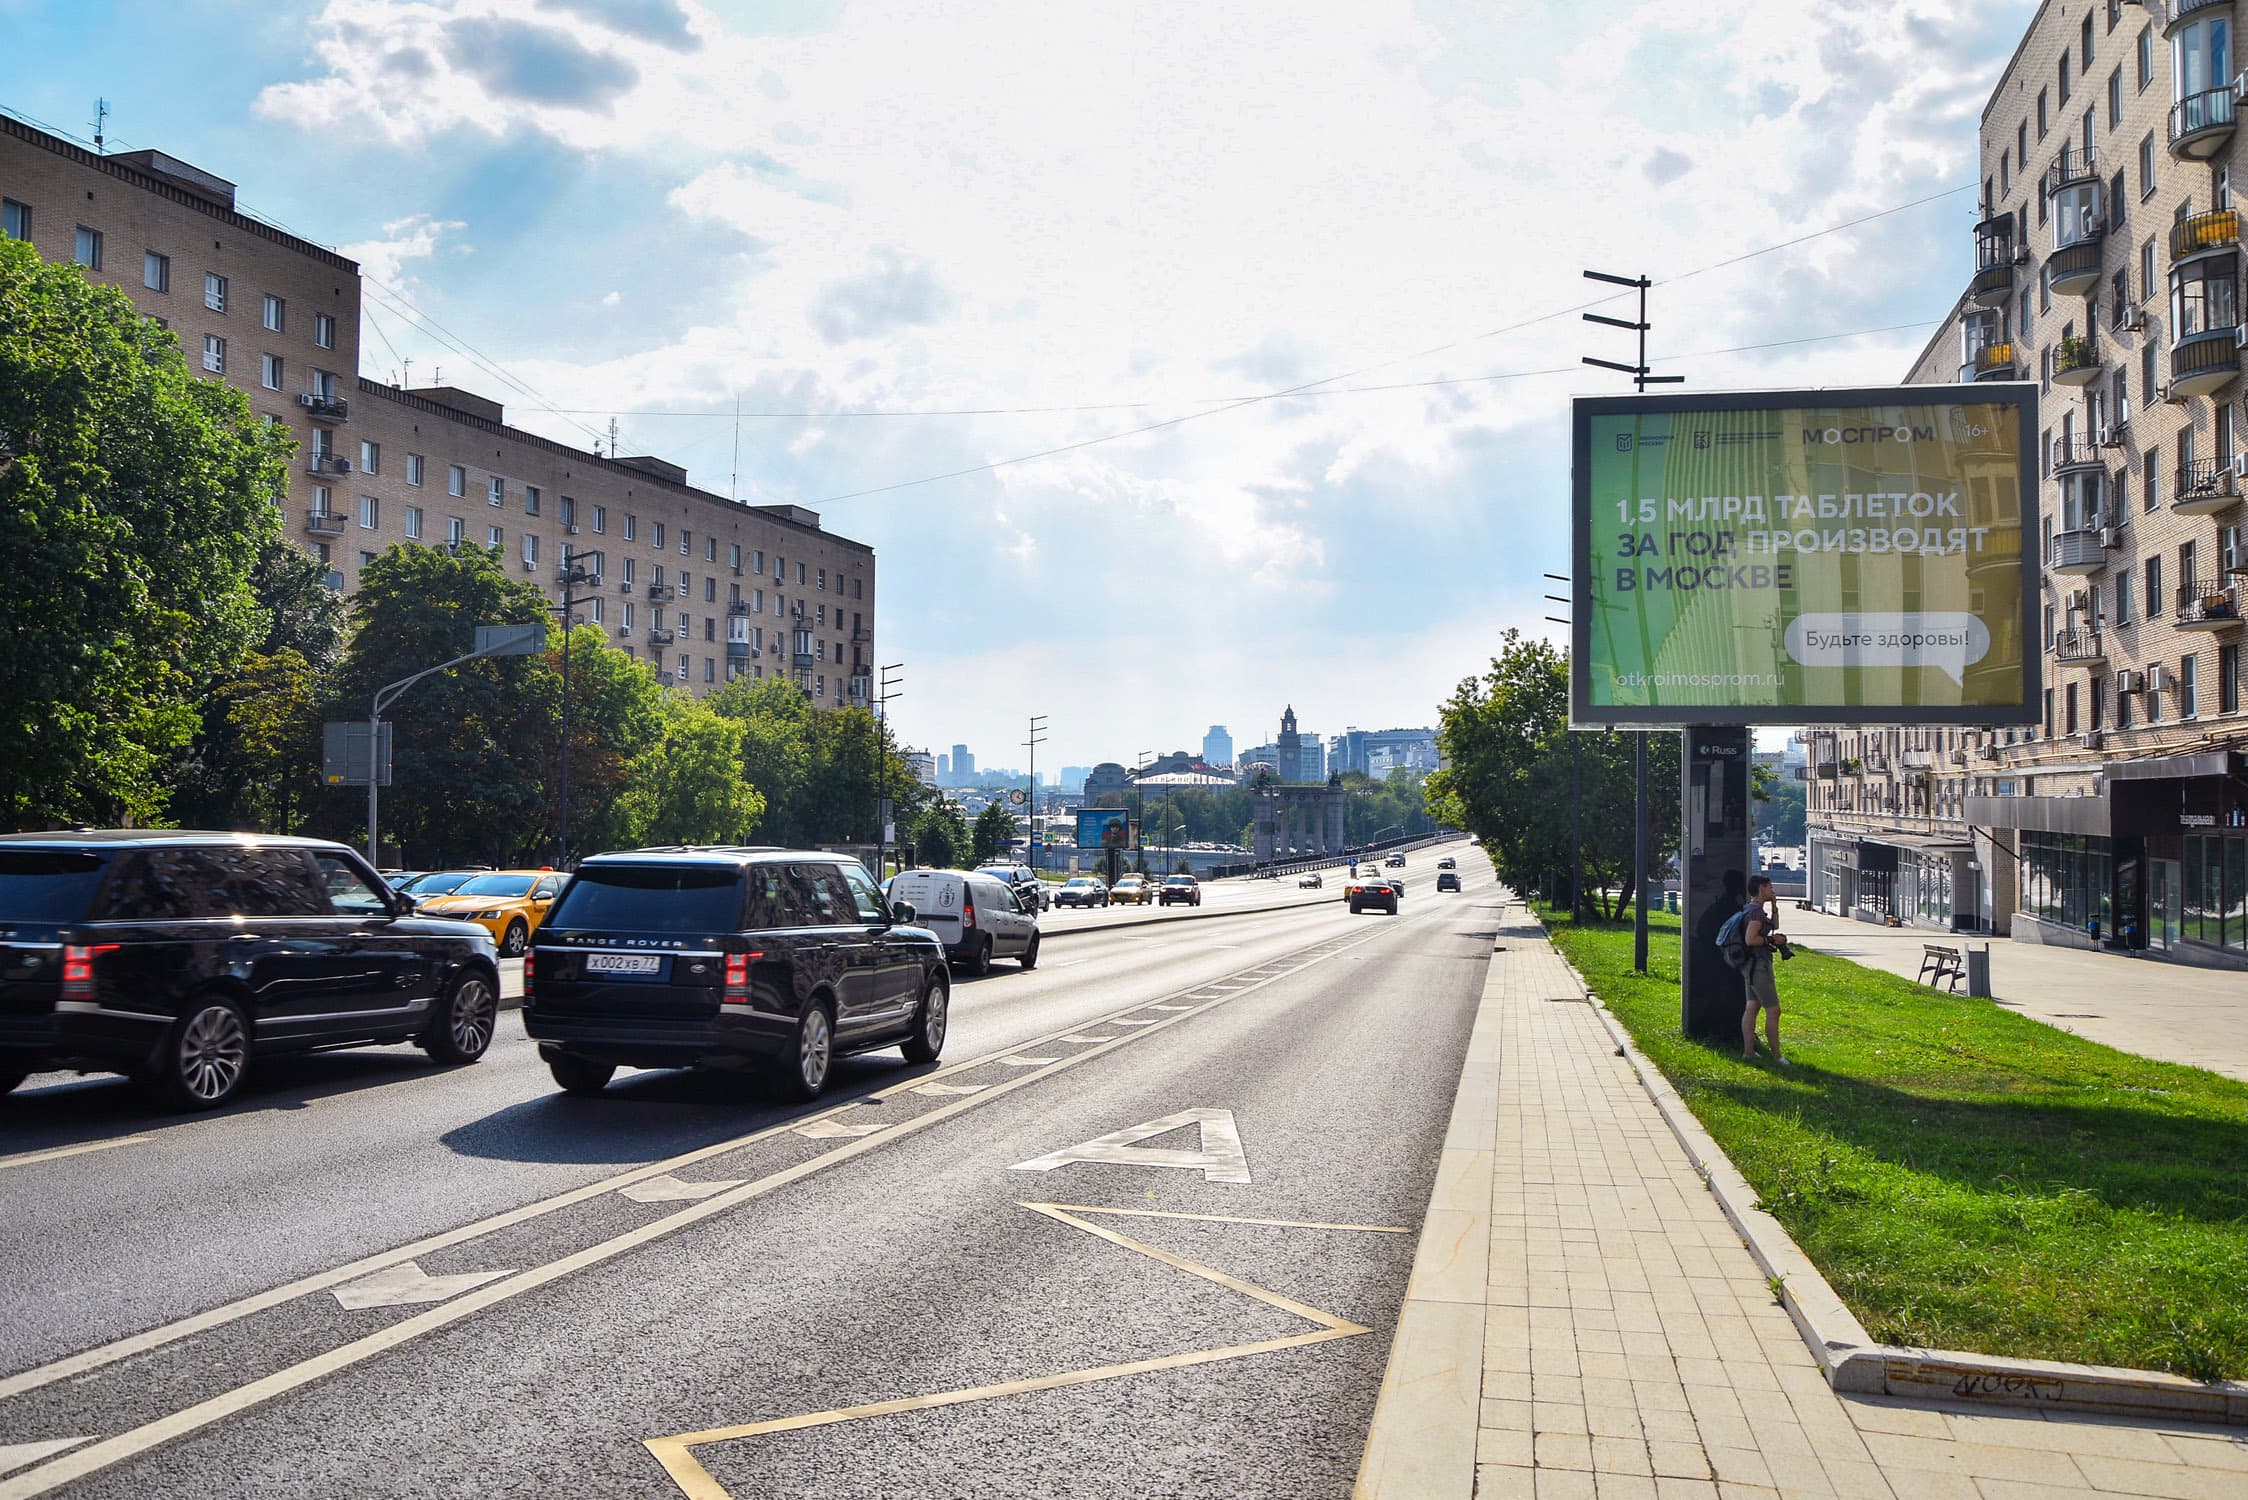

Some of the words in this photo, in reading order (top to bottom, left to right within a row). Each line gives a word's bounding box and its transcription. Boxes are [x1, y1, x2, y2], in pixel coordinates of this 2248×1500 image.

[1802, 426, 1934, 445] МОСПРОМ
[1966, 424, 1990, 438] 16+
[1616, 498, 1657, 526] 1,5
[1667, 496, 1767, 525] МЛРД
[1774, 492, 1960, 520] ТАБЛЕТОК
[1617, 533, 1659, 558] ЗА
[1669, 531, 1737, 560] ГОД
[1747, 527, 1989, 557] ПРОИЗВОДЯТ
[1616, 567, 1637, 592] В
[1646, 564, 1793, 591] МОСКВЕ
[1806, 631, 1872, 650] Будьте
[1877, 630, 1970, 650] здоровы!
[1615, 671, 1785, 690] otkroimosprom.ru
[1711, 745, 1737, 755] Russ
[566, 937, 617, 946] RANGE
[626, 939, 683, 948] ROVER
